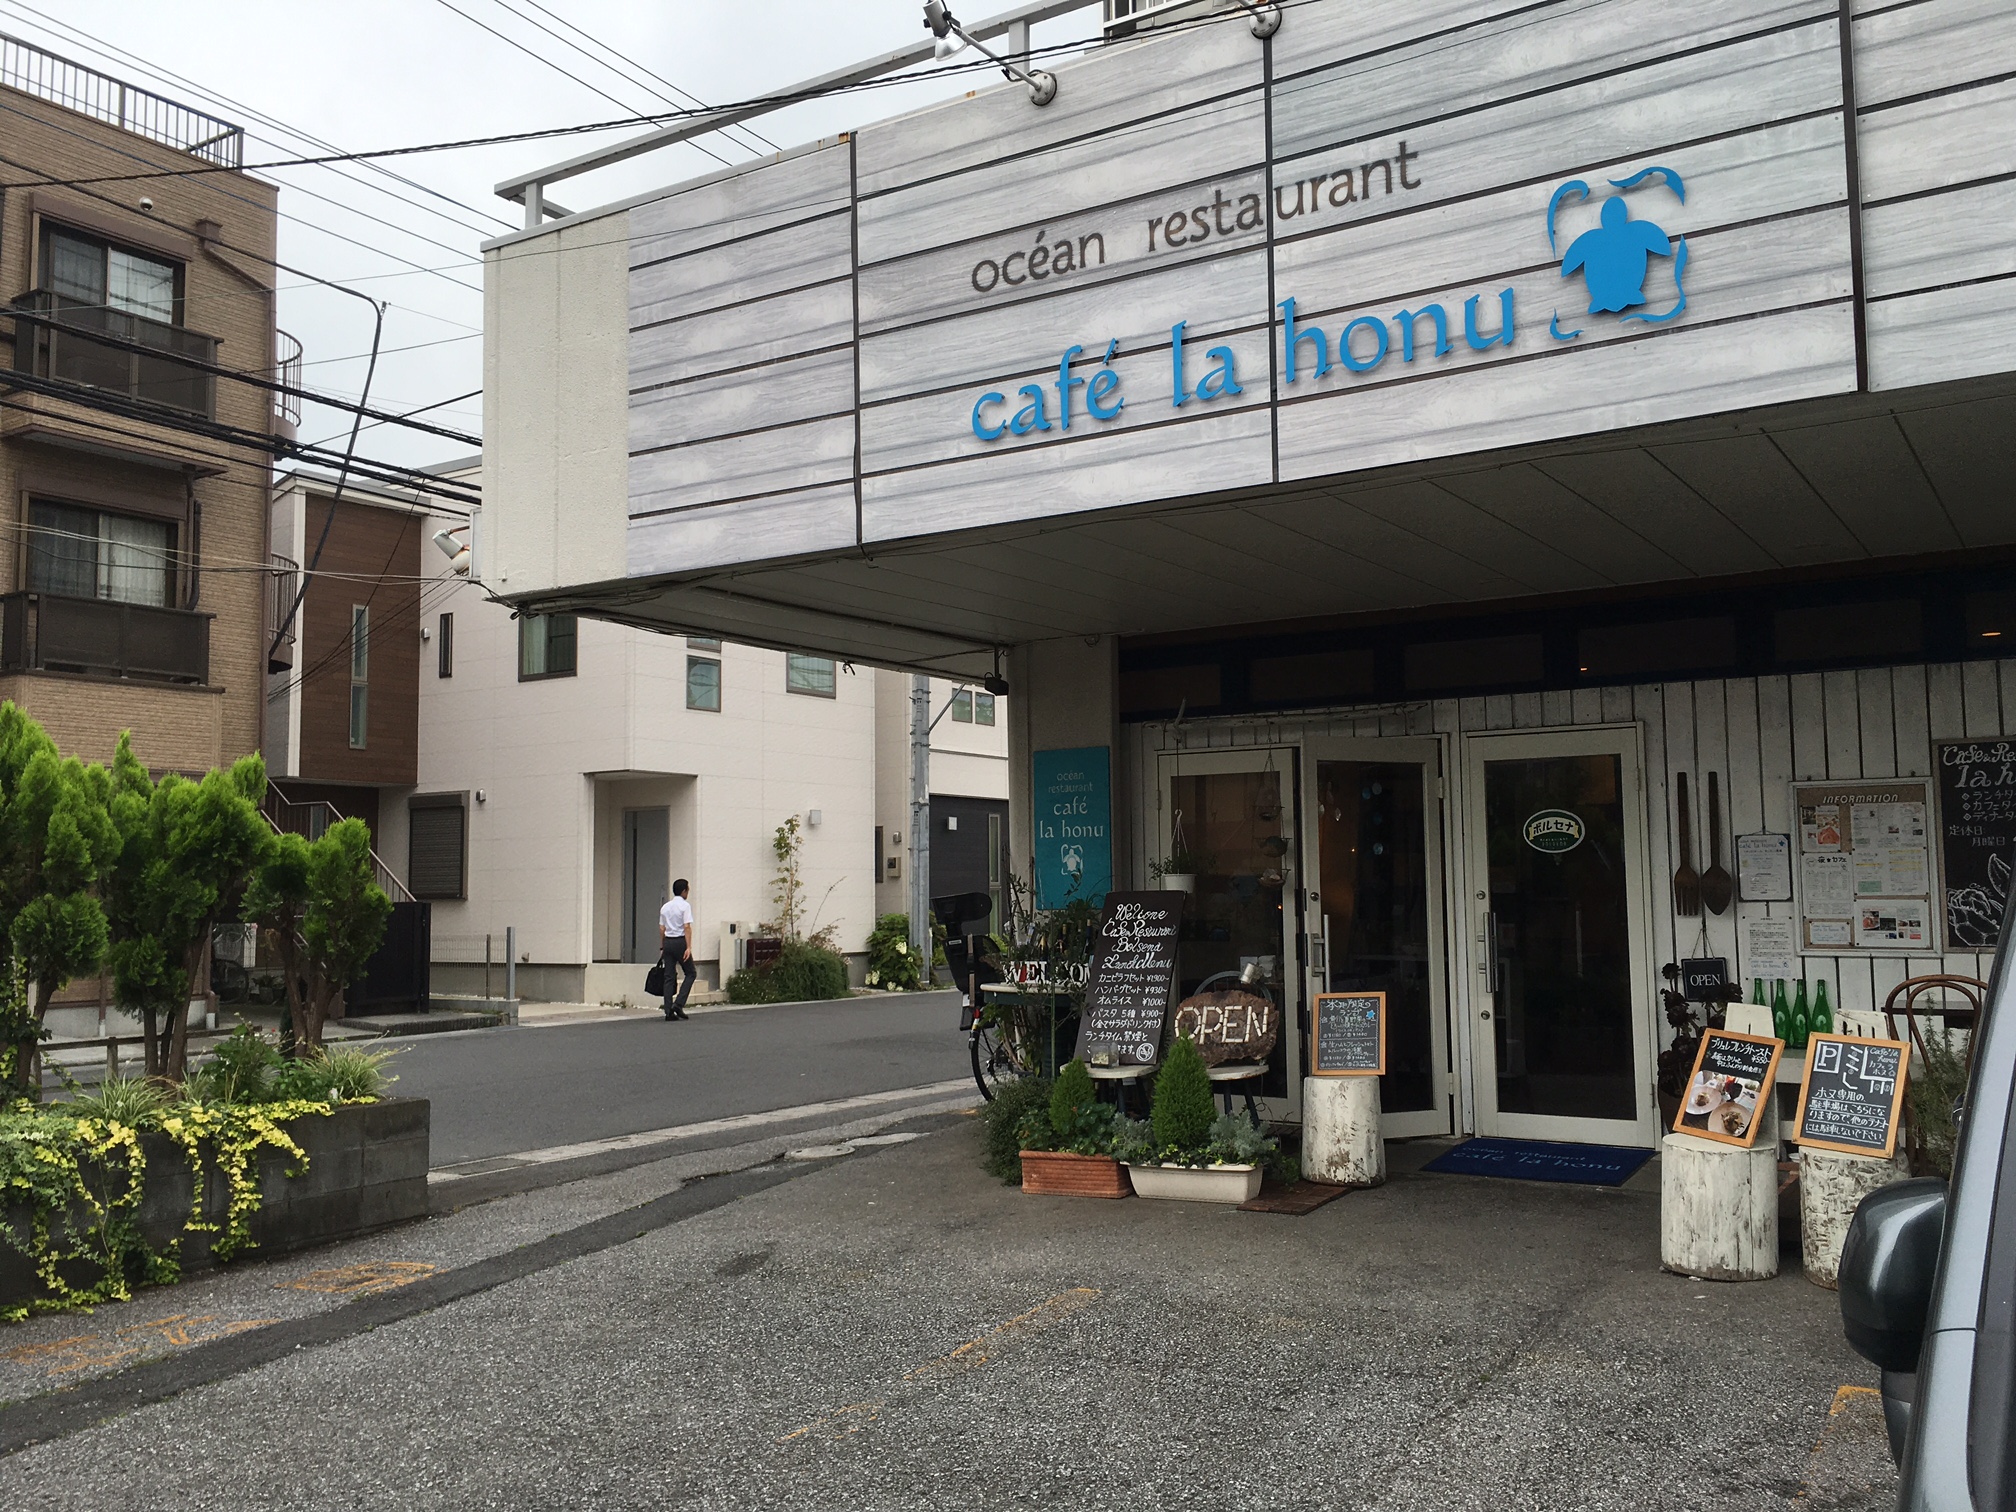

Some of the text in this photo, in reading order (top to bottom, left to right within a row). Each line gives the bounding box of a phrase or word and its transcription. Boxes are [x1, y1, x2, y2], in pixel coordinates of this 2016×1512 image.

[970, 141, 1421, 293] océan restaurant
[971, 286, 1514, 441] café la honu
[1056, 771, 1084, 782] océan
[1048, 782, 1093, 794] restaurant
[1822, 793, 1899, 804] INFORMATION
[1053, 796, 1088, 816] café
[1039, 820, 1104, 838] la honu
[1533, 819, 1574, 835] ボルセナ
[1098, 972, 1145, 983] カニピラフセット
[1690, 974, 1721, 986] OPEN
[1096, 995, 1132, 1005] オムライス
[1091, 1008, 1118, 1018] パスタ
[1174, 1005, 1269, 1044] OPEN
[1817, 1045, 1837, 1067] P
[1554, 1159, 1621, 1171] honu
